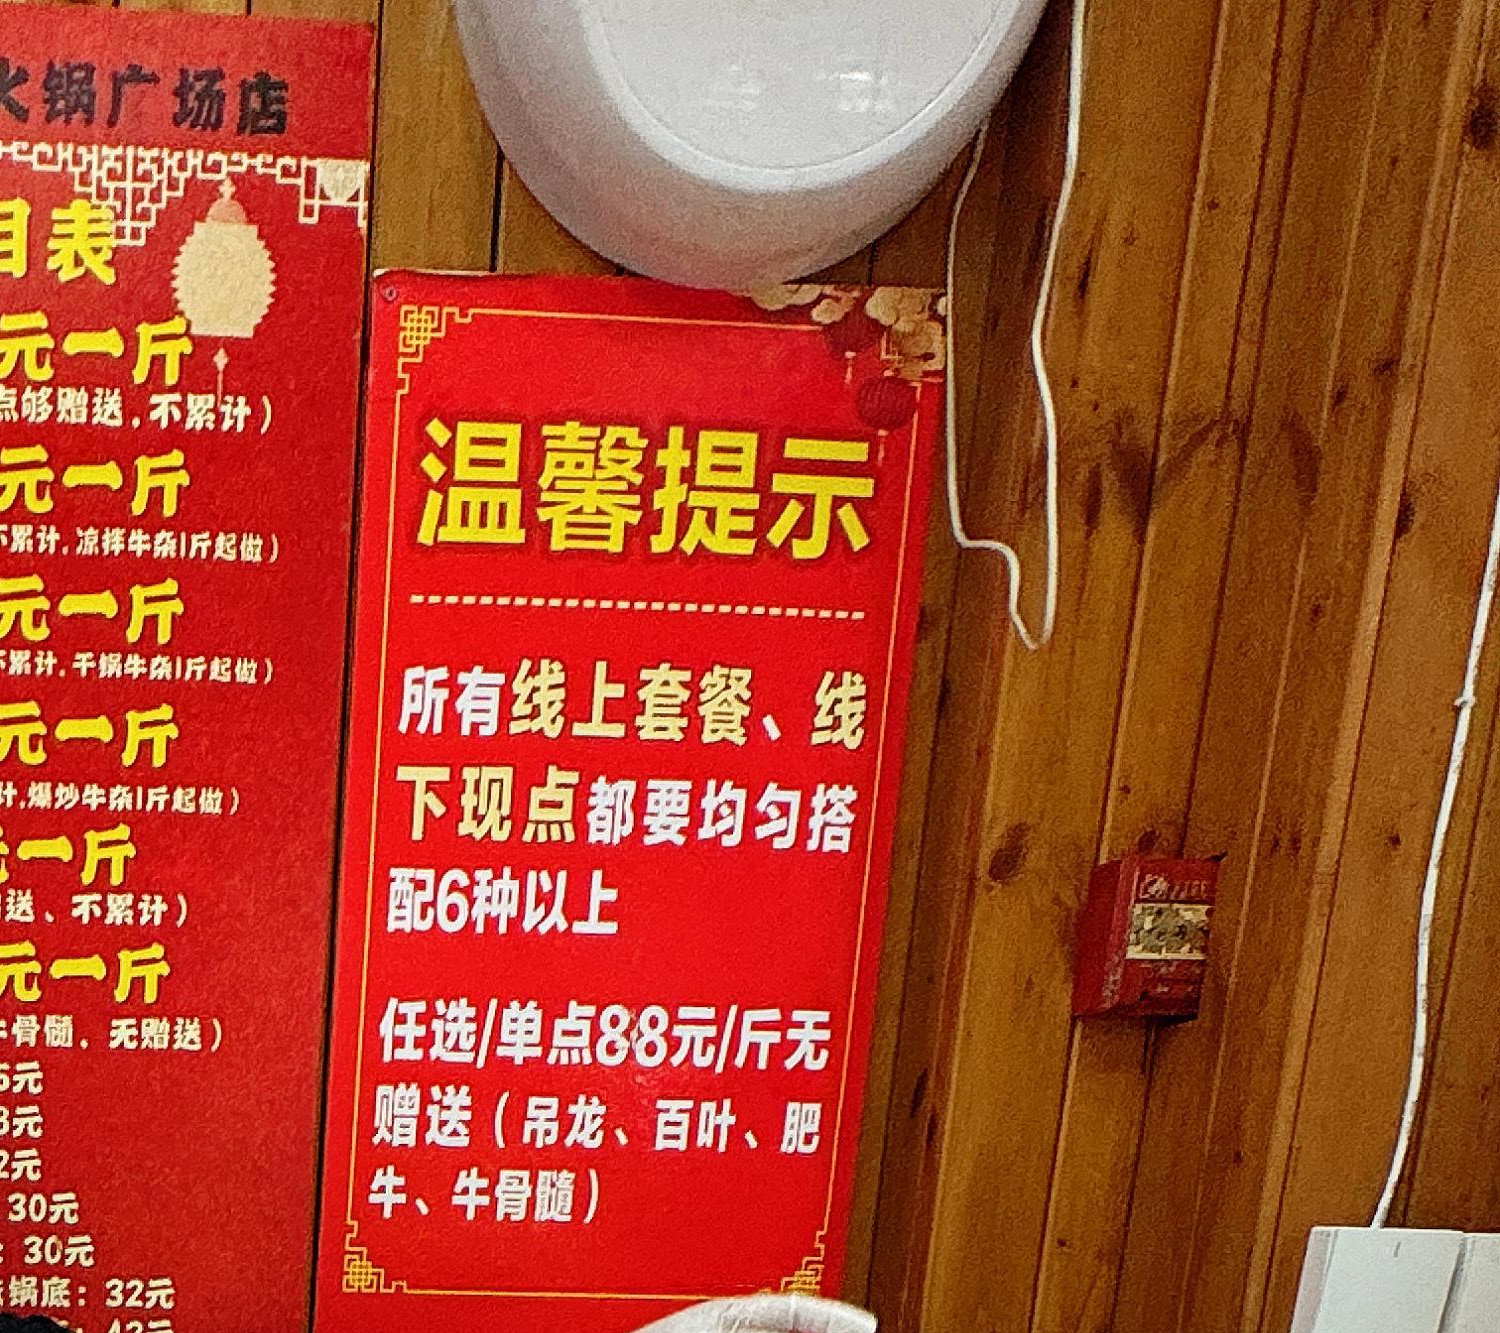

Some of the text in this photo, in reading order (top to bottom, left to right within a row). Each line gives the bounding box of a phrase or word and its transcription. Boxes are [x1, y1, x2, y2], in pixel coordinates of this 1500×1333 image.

[415, 415, 878, 562] 温馨提示
[397, 657, 867, 749] 所有线上套餐、线
[395, 762, 860, 854] 下现点都要均匀搭
[386, 865, 620, 937] 配6种以上
[378, 996, 832, 1074] 任选/单点88元/斤无
[371, 1081, 823, 1154] 赠送（吊龙、百叶、肥
